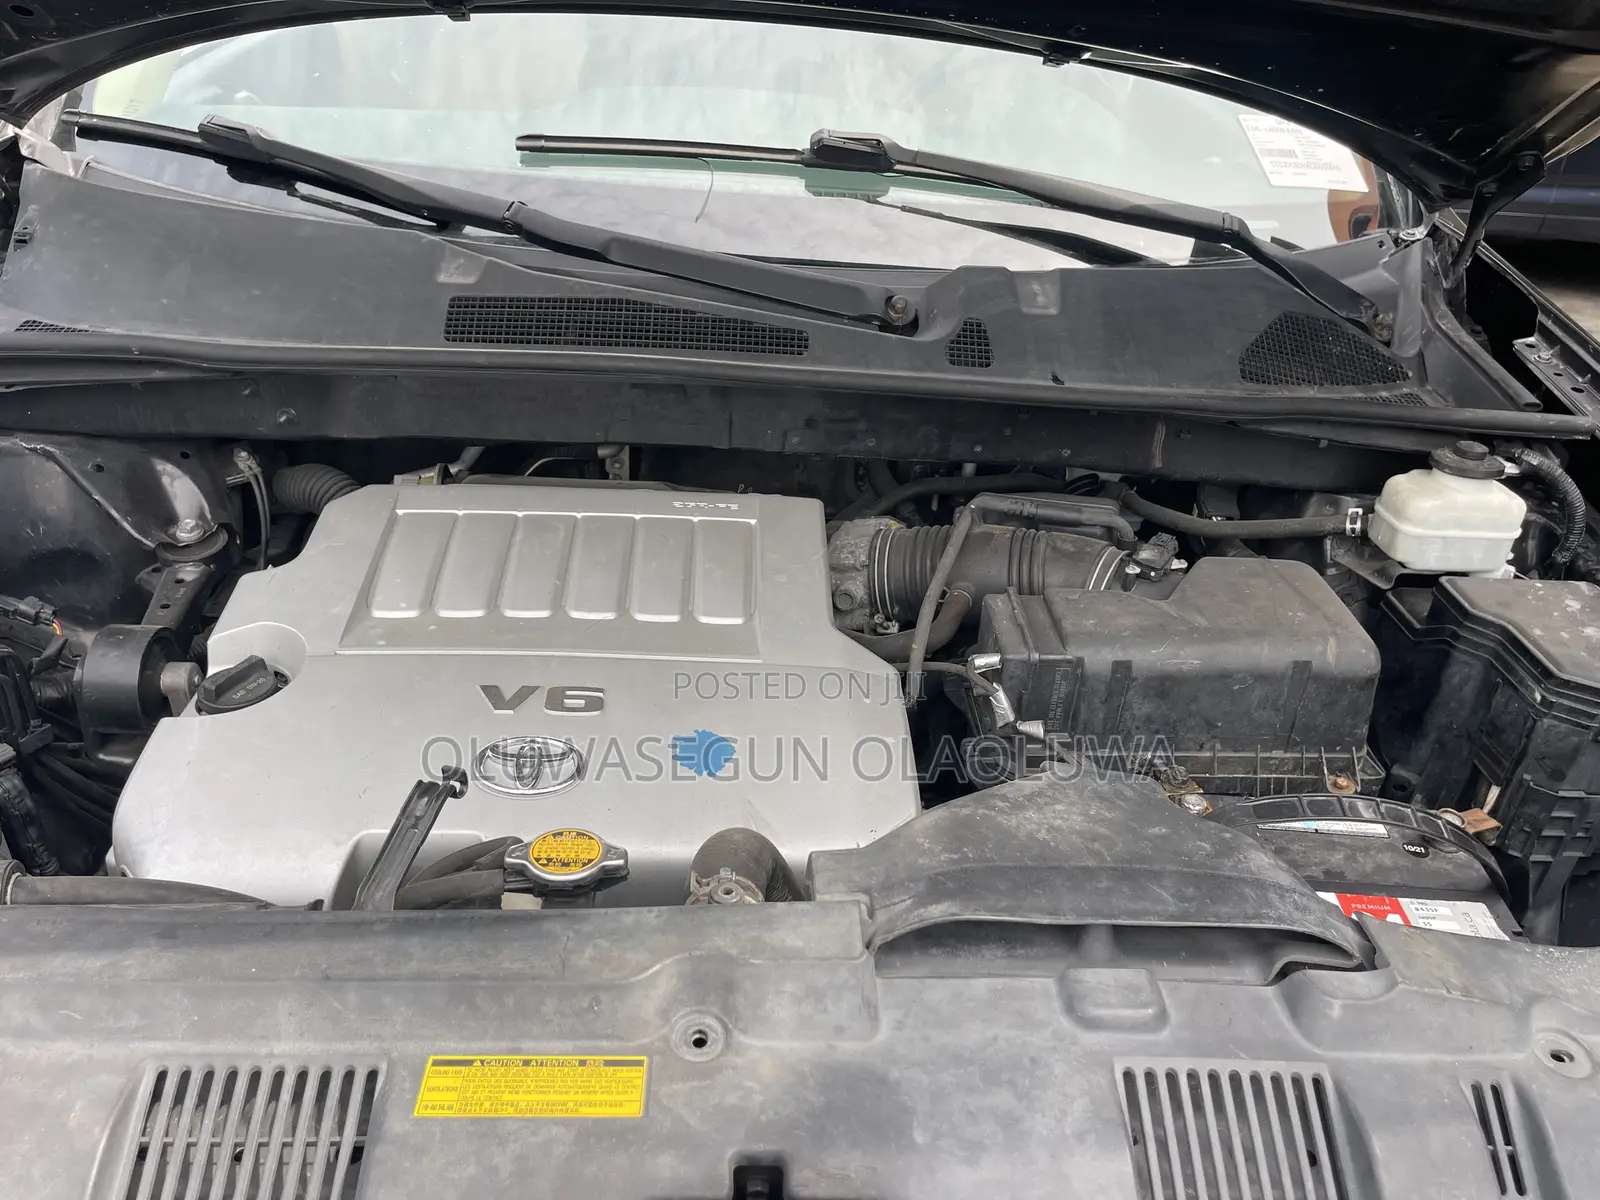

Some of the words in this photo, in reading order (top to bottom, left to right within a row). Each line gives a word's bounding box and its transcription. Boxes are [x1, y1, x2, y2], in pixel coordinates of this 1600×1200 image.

[476, 684, 606, 716] V6
[1403, 844, 1426, 854] 10/21
[1350, 902, 1392, 911] PREMIUM
[484, 1059, 523, 1067] CAUTION
[529, 1059, 579, 1067] ATTENTION
